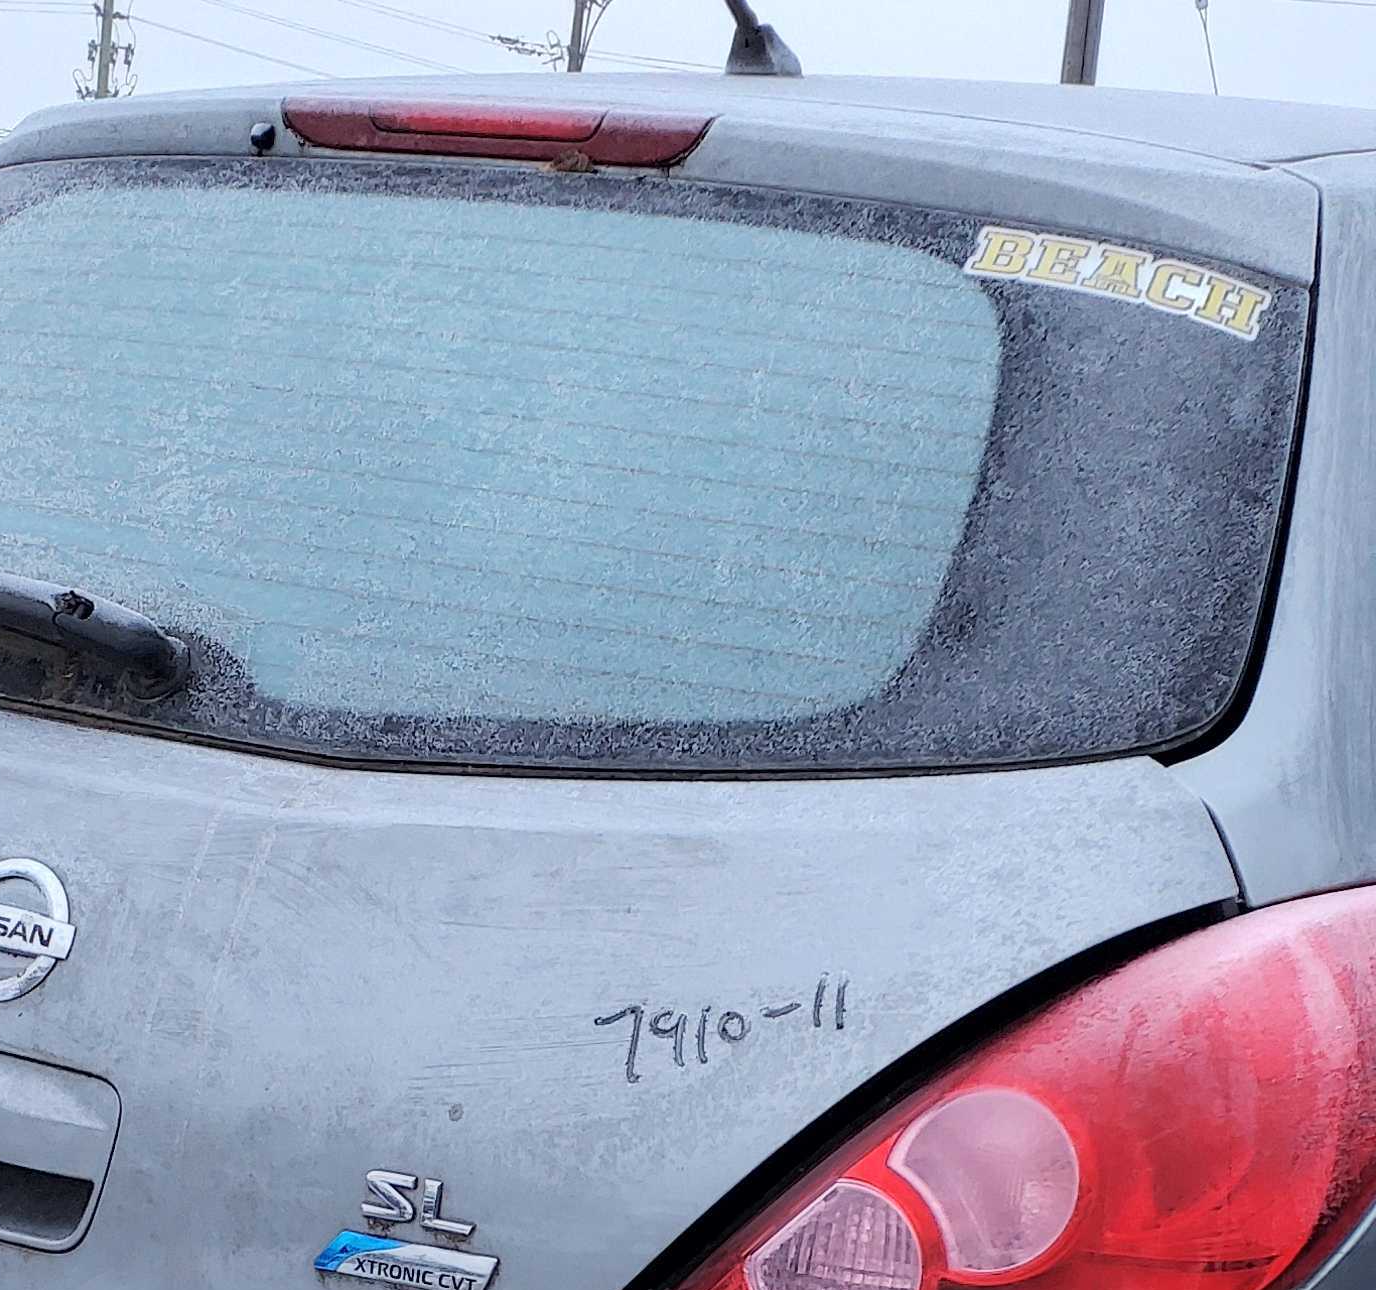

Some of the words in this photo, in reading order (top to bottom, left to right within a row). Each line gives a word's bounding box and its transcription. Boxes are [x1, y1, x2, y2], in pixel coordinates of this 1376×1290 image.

[973, 229, 1266, 336] BEACH
[594, 971, 850, 1083] 7910-11
[361, 1169, 476, 1237] SL
[354, 1257, 433, 1286] XTRONIC
